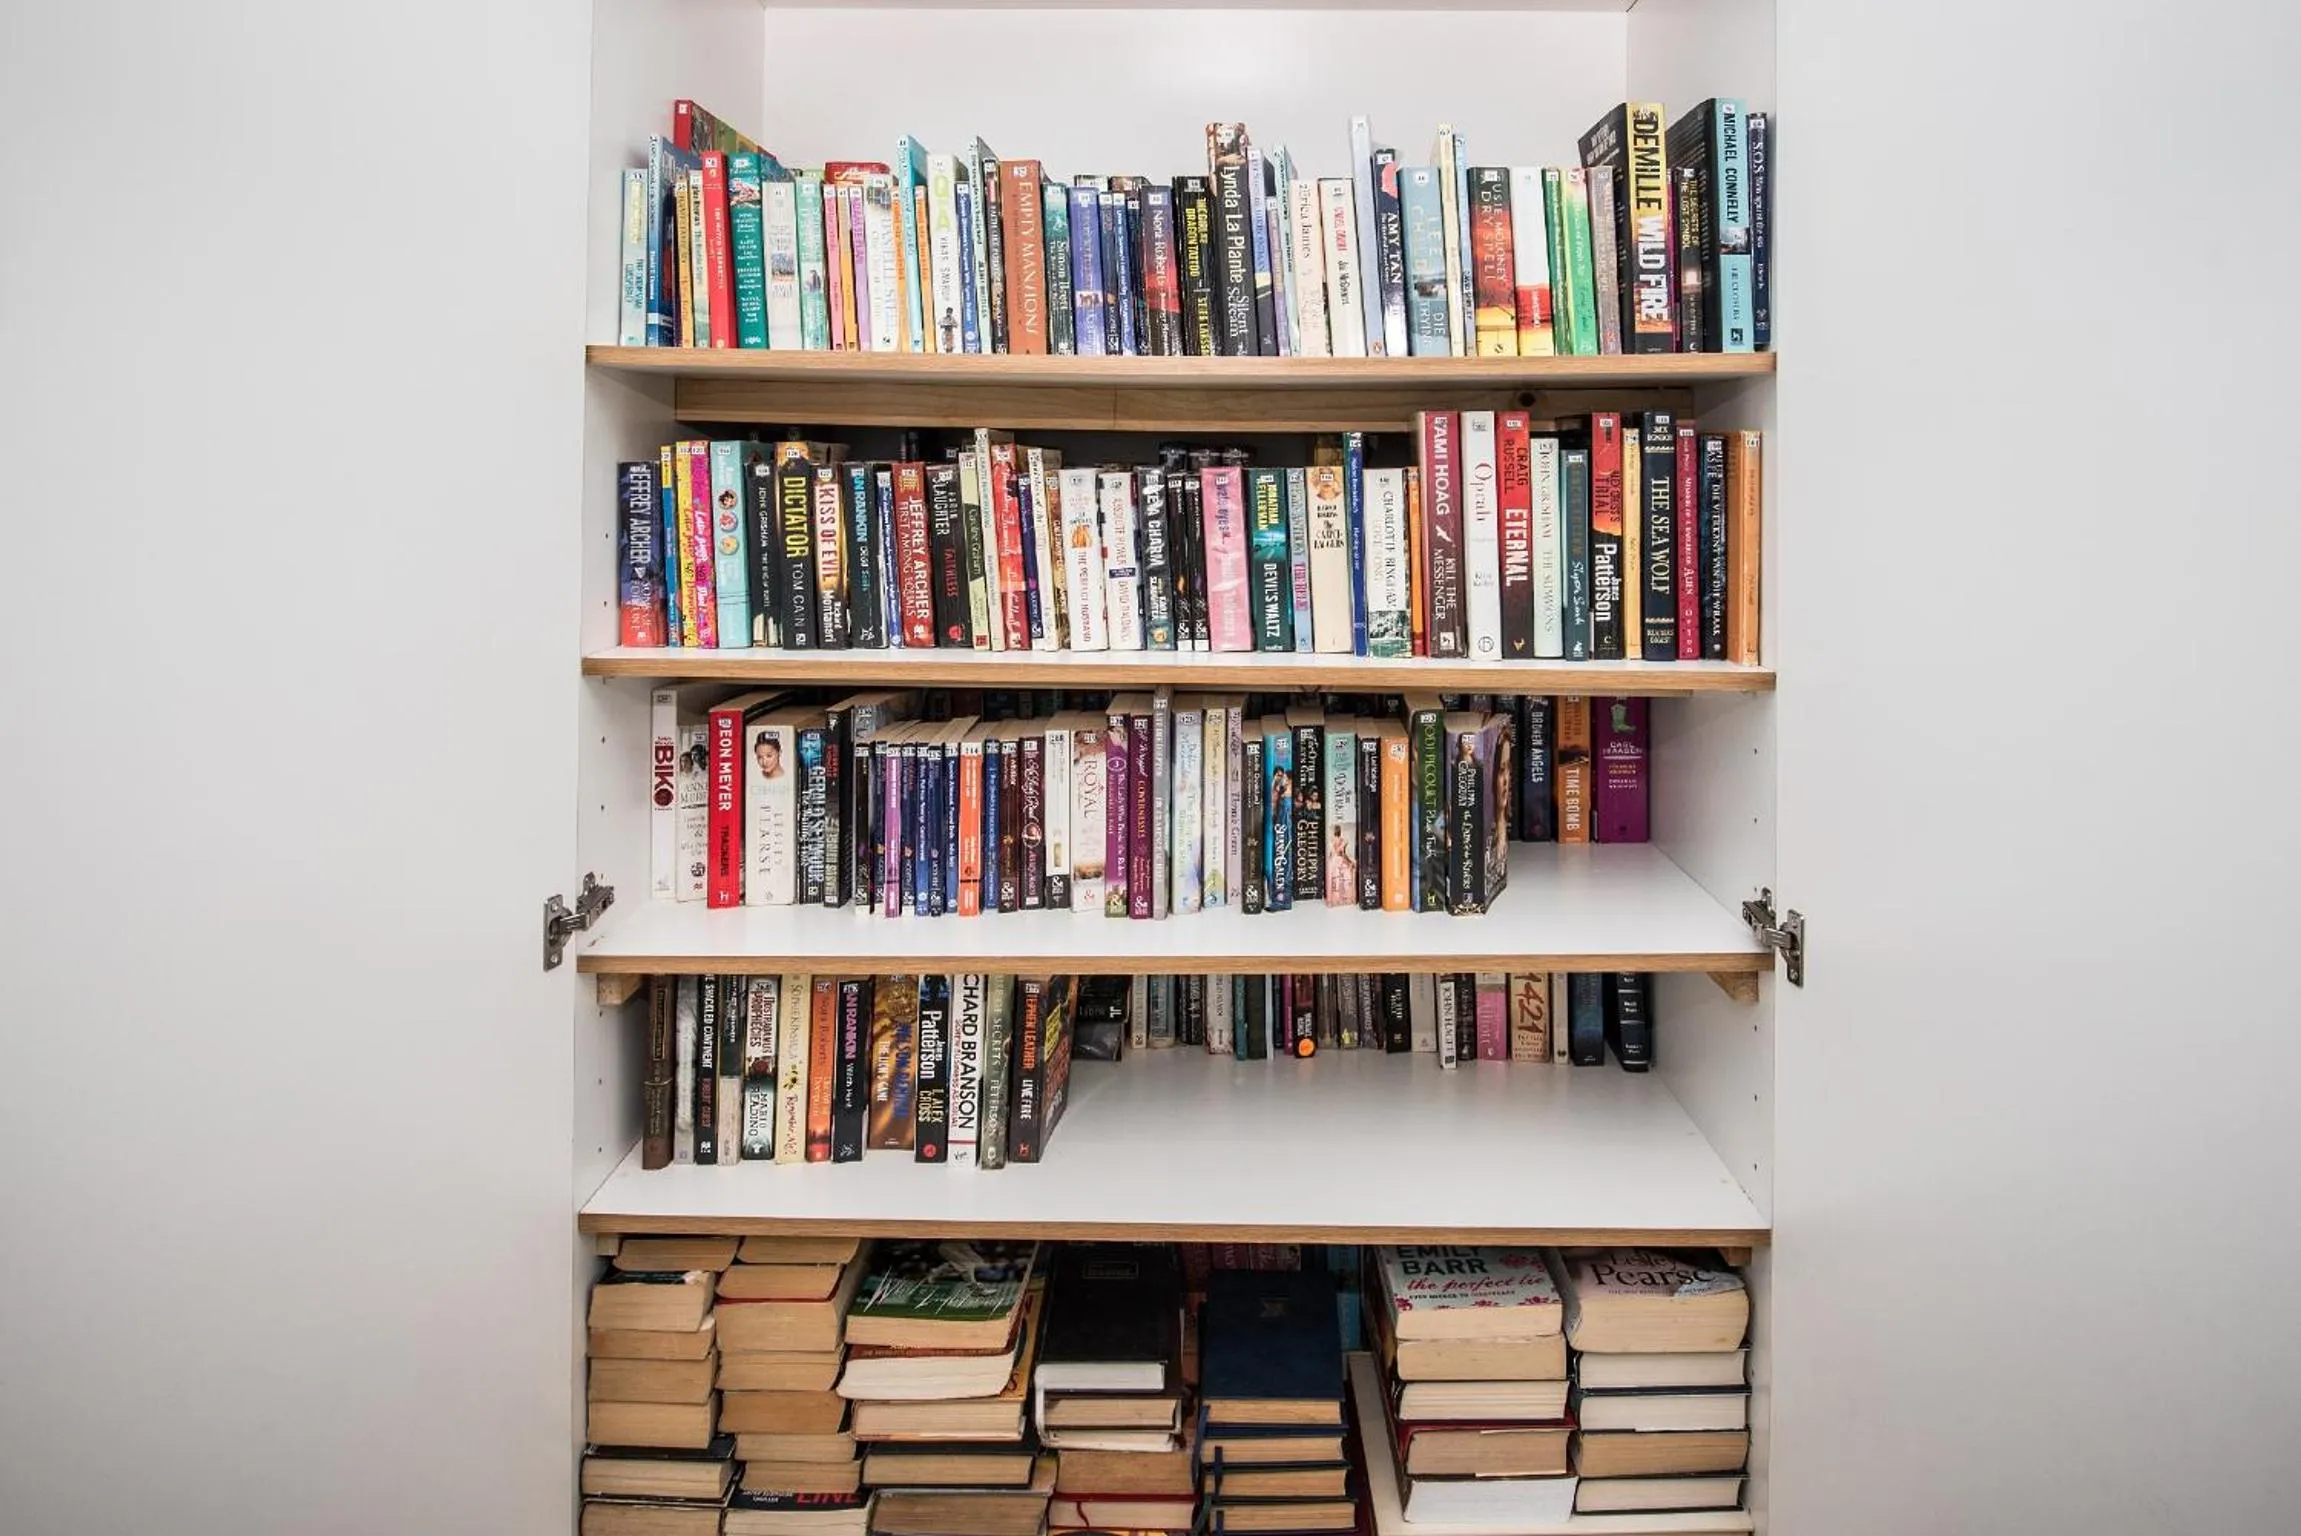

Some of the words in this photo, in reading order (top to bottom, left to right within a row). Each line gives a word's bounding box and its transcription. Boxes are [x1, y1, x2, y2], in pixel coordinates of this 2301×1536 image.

[1723, 113, 1739, 161] MICHAEL
[1633, 120, 1662, 210] DEMILLE
[1221, 166, 1241, 208] Lynda
[1682, 197, 1690, 216] LOST
[1689, 179, 1698, 195] THE
[1725, 168, 1740, 223] CONNELLY
[1017, 181, 1036, 235] EMPTY
[1153, 209, 1164, 237] Nora
[1186, 207, 1199, 246] DRAGON
[1226, 214, 1241, 232] La
[1480, 191, 1492, 225] DRY
[1690, 197, 1699, 232] SECRETS
[1302, 224, 1314, 259] James
[1387, 212, 1400, 248] AMY
[1411, 205, 1428, 270] CHILD
[1428, 216, 1443, 257] LEE
[1637, 216, 1666, 269] WILD
[1682, 218, 1691, 249] SYMBOL
[1057, 240, 1069, 277] Simon
[1155, 242, 1168, 285] Roberts
[1189, 246, 1201, 277] TATTOO
[1227, 236, 1247, 283] Plante
[1389, 251, 1402, 283] TAN
[1482, 233, 1495, 282] SPELL
[1494, 221, 1506, 282] MOLONEY
[1020, 243, 1038, 335] MANSIONS
[1058, 281, 1070, 310] Brett
[1639, 275, 1668, 320] FIRE
[1227, 286, 1239, 337] Scream
[1236, 296, 1250, 335] Silent
[1432, 312, 1445, 335] DIE
[1504, 439, 1516, 494] RUSSELL
[1516, 446, 1528, 486] CRAIG
[757, 487, 767, 508] JOHN
[819, 487, 837, 526] KISS
[932, 477, 949, 535] SLAUGHTER
[1256, 478, 1269, 530] KELLERMAN
[1267, 484, 1280, 524] JONATHAN
[1435, 464, 1450, 516] HOAG
[1470, 462, 1493, 524] Oprah
[1595, 477, 1609, 516] TRIAL
[1651, 476, 1670, 510] THE
[759, 510, 769, 547] GRISHAM
[783, 477, 809, 558] DICTATOR
[855, 491, 868, 542] RANKIN
[898, 501, 911, 528] FIRST
[909, 498, 927, 554] JEFFREY
[969, 509, 980, 541] Caroline
[1382, 491, 1396, 553] CHARLOTTE
[1651, 514, 1670, 545] SEA
[629, 519, 652, 564] ARCHER
[820, 529, 838, 546] OF
[901, 533, 914, 573] AMONG
[1147, 520, 1165, 567] CHARM
[1505, 508, 1528, 587] ETERNAL
[793, 562, 805, 590] TOM
[821, 550, 839, 581] EVIL
[971, 543, 982, 575] Graham
[1077, 551, 1088, 566] THE
[1446, 558, 1457, 581] KILL
[1650, 546, 1671, 595] WOLF
[902, 577, 916, 616] EQUALS
[914, 560, 929, 618] ARCHER
[1263, 563, 1279, 600] DEVIL'S
[1433, 547, 1446, 620] MESSENGER
[1446, 586, 1457, 609] THE
[1595, 543, 1618, 622] Patterson
[794, 594, 806, 627] CAIN
[823, 590, 836, 643] Montanari
[833, 600, 842, 629] Richard
[1265, 603, 1281, 638] WALTZ
[1531, 711, 1545, 746] BROKEN
[1425, 754, 1437, 807] PICOULT
[1457, 760, 1468, 807] GREGORY
[1532, 749, 1545, 783] ANGELS
[1565, 767, 1580, 795] TIME
[719, 763, 733, 812] MEYER
[807, 766, 826, 816] GERALD
[1083, 759, 1098, 818] ROYAL
[1467, 768, 1476, 807] PHILIPPA
[1566, 798, 1581, 832] BOMB
[759, 805, 771, 874] PEARSE
[808, 819, 826, 883] SEYMOUR
[1297, 819, 1309, 882] GREGORY
[1307, 821, 1319, 881] PHILIPPA
[703, 984, 715, 1024] SHACKLED
[750, 990, 763, 1048] PROPHECIES
[962, 975, 980, 1036] CHARD
[1025, 993, 1038, 1028] TEPHEN
[1514, 973, 1546, 1036] 1421
[762, 996, 775, 1056] NOSTRADAMUS
[845, 1008, 857, 1059] RANKIN
[920, 1010, 942, 1079] Patterson
[992, 1017, 1004, 1066] SECRETS
[702, 1025, 714, 1069] CONTINENT
[1023, 1030, 1037, 1069] LEATHER
[958, 1041, 978, 1129] BRANSON
[1021, 1079, 1034, 1099] LIVE
[748, 1086, 761, 1137] READING
[759, 1093, 769, 1129] MARIO
[919, 1088, 931, 1123] CROSS
[932, 1098, 943, 1123] ALEX
[988, 1079, 1001, 1137] PETERSON
[1020, 1099, 1033, 1120] FIRE
[1402, 1259, 1489, 1276] BARR
[1407, 1277, 1438, 1291] the
[1443, 1276, 1515, 1292] perfect
[1591, 1263, 1714, 1286] Pearse
